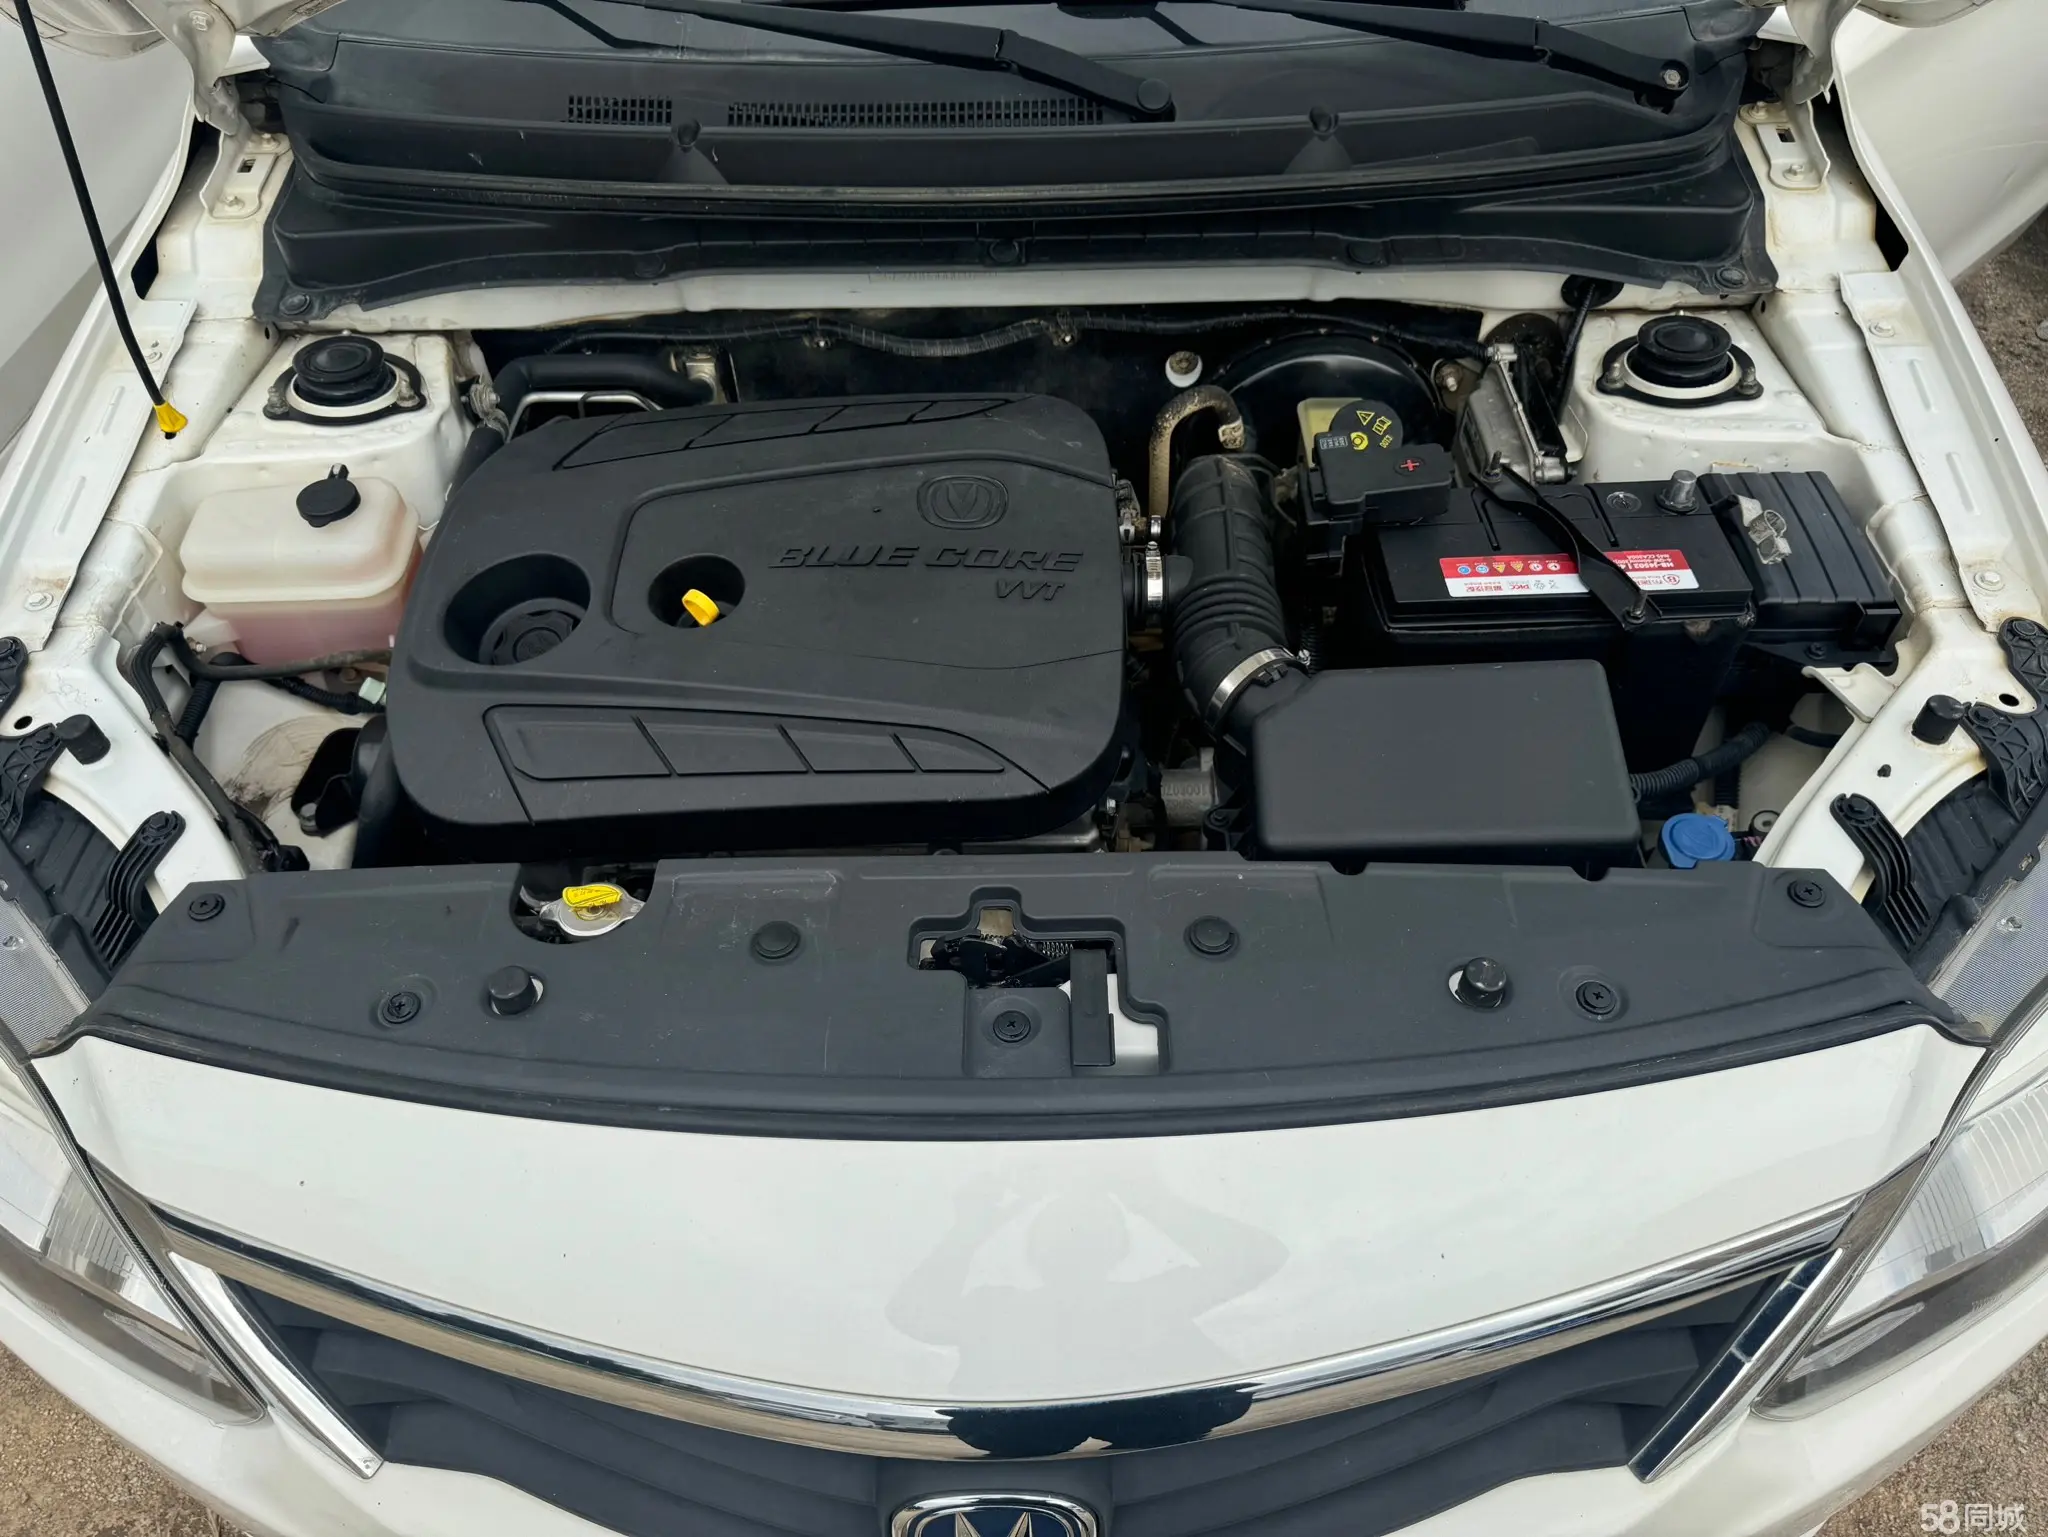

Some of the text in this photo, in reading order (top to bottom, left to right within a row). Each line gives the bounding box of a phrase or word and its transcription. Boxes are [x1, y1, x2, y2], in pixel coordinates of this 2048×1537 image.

[768, 545, 1084, 572] BLUE CORE
[995, 580, 1066, 602] VVT
